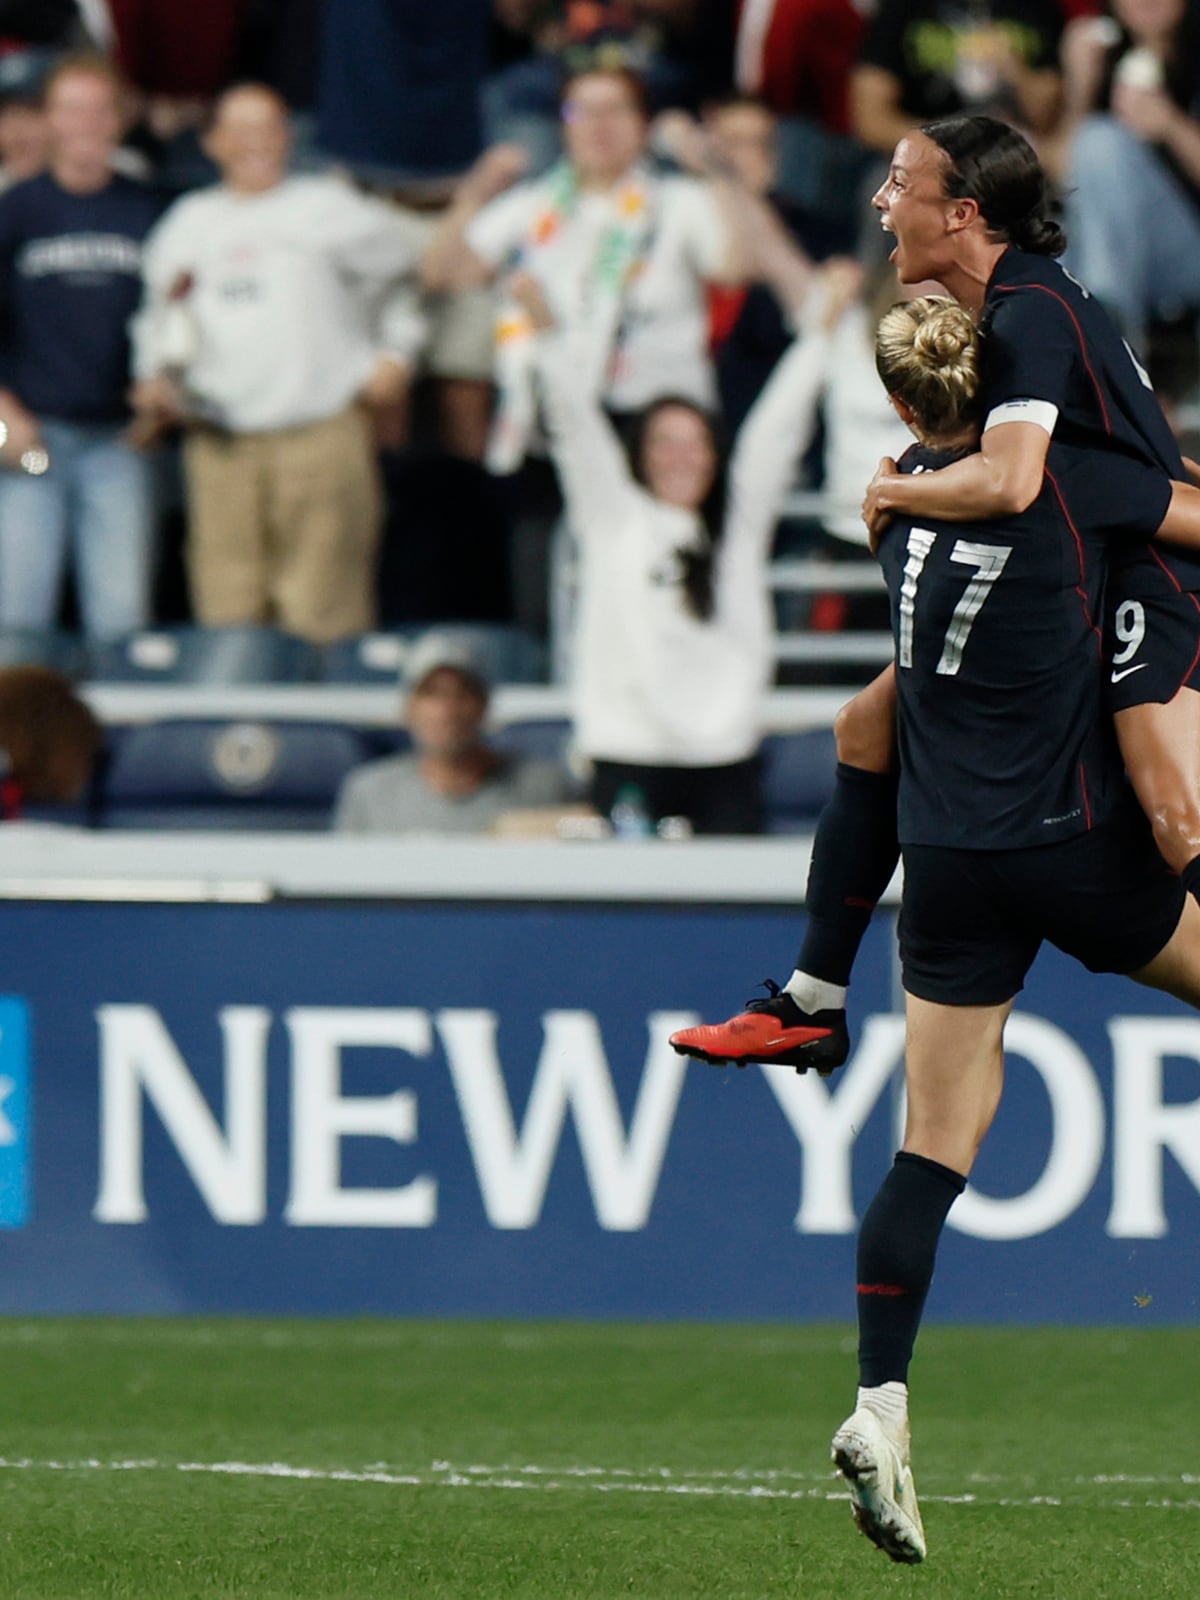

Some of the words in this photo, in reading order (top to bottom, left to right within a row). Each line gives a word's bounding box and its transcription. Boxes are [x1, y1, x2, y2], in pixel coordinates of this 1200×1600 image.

[899, 526, 1013, 676] 17
[1111, 599, 1146, 665] 9
[92, 1003, 702, 1232] NEW
